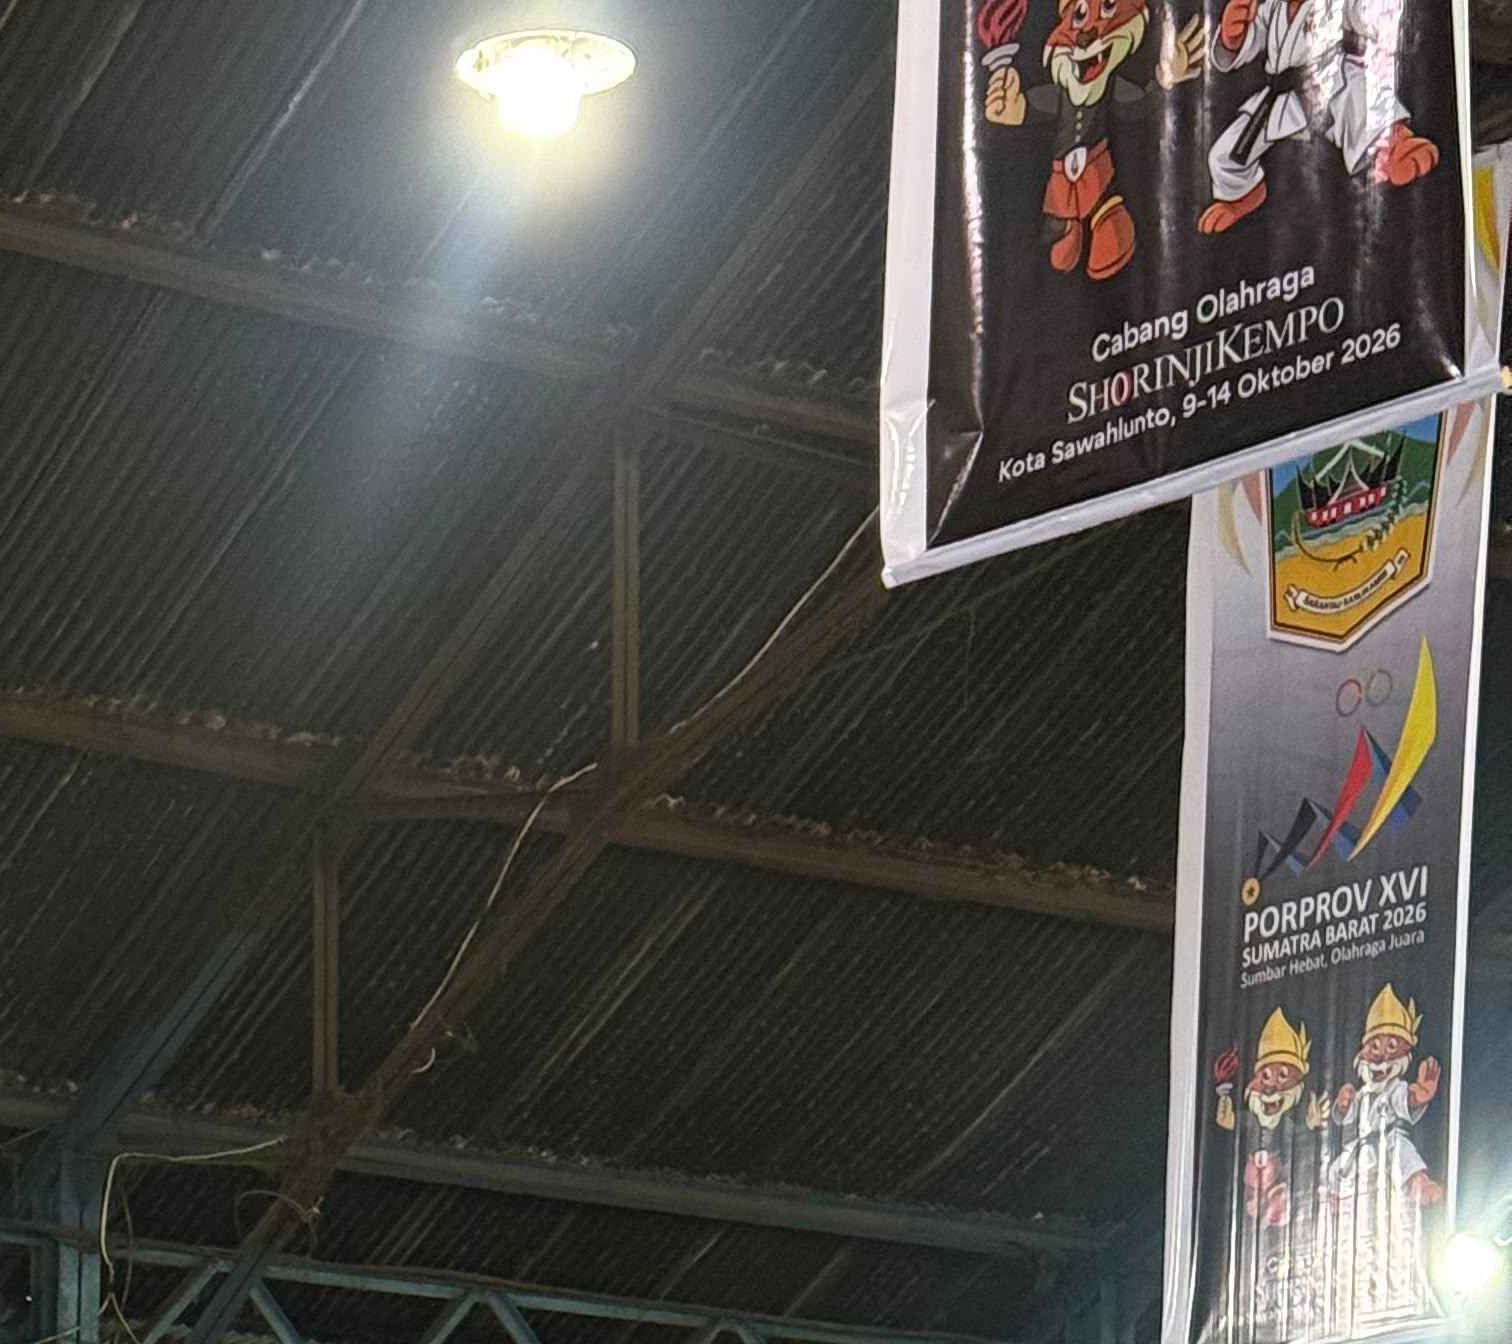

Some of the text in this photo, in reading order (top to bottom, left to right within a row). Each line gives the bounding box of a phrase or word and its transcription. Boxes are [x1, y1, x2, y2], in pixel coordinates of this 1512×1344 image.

[1091, 265, 1315, 363] Cabang Olahraga
[998, 323, 1401, 483] Kota Sawahlunto, 9-14 Oktober 2026
[1066, 296, 1345, 425] SHORINJIKEMPO
[1242, 902, 1427, 968] SUMATRA BARAT 2026
[1243, 865, 1428, 943] PORPROV XVI
[1240, 963, 1286, 989] Sumbar
[1330, 937, 1386, 965] Olahraga
[1388, 928, 1425, 950] Juara
